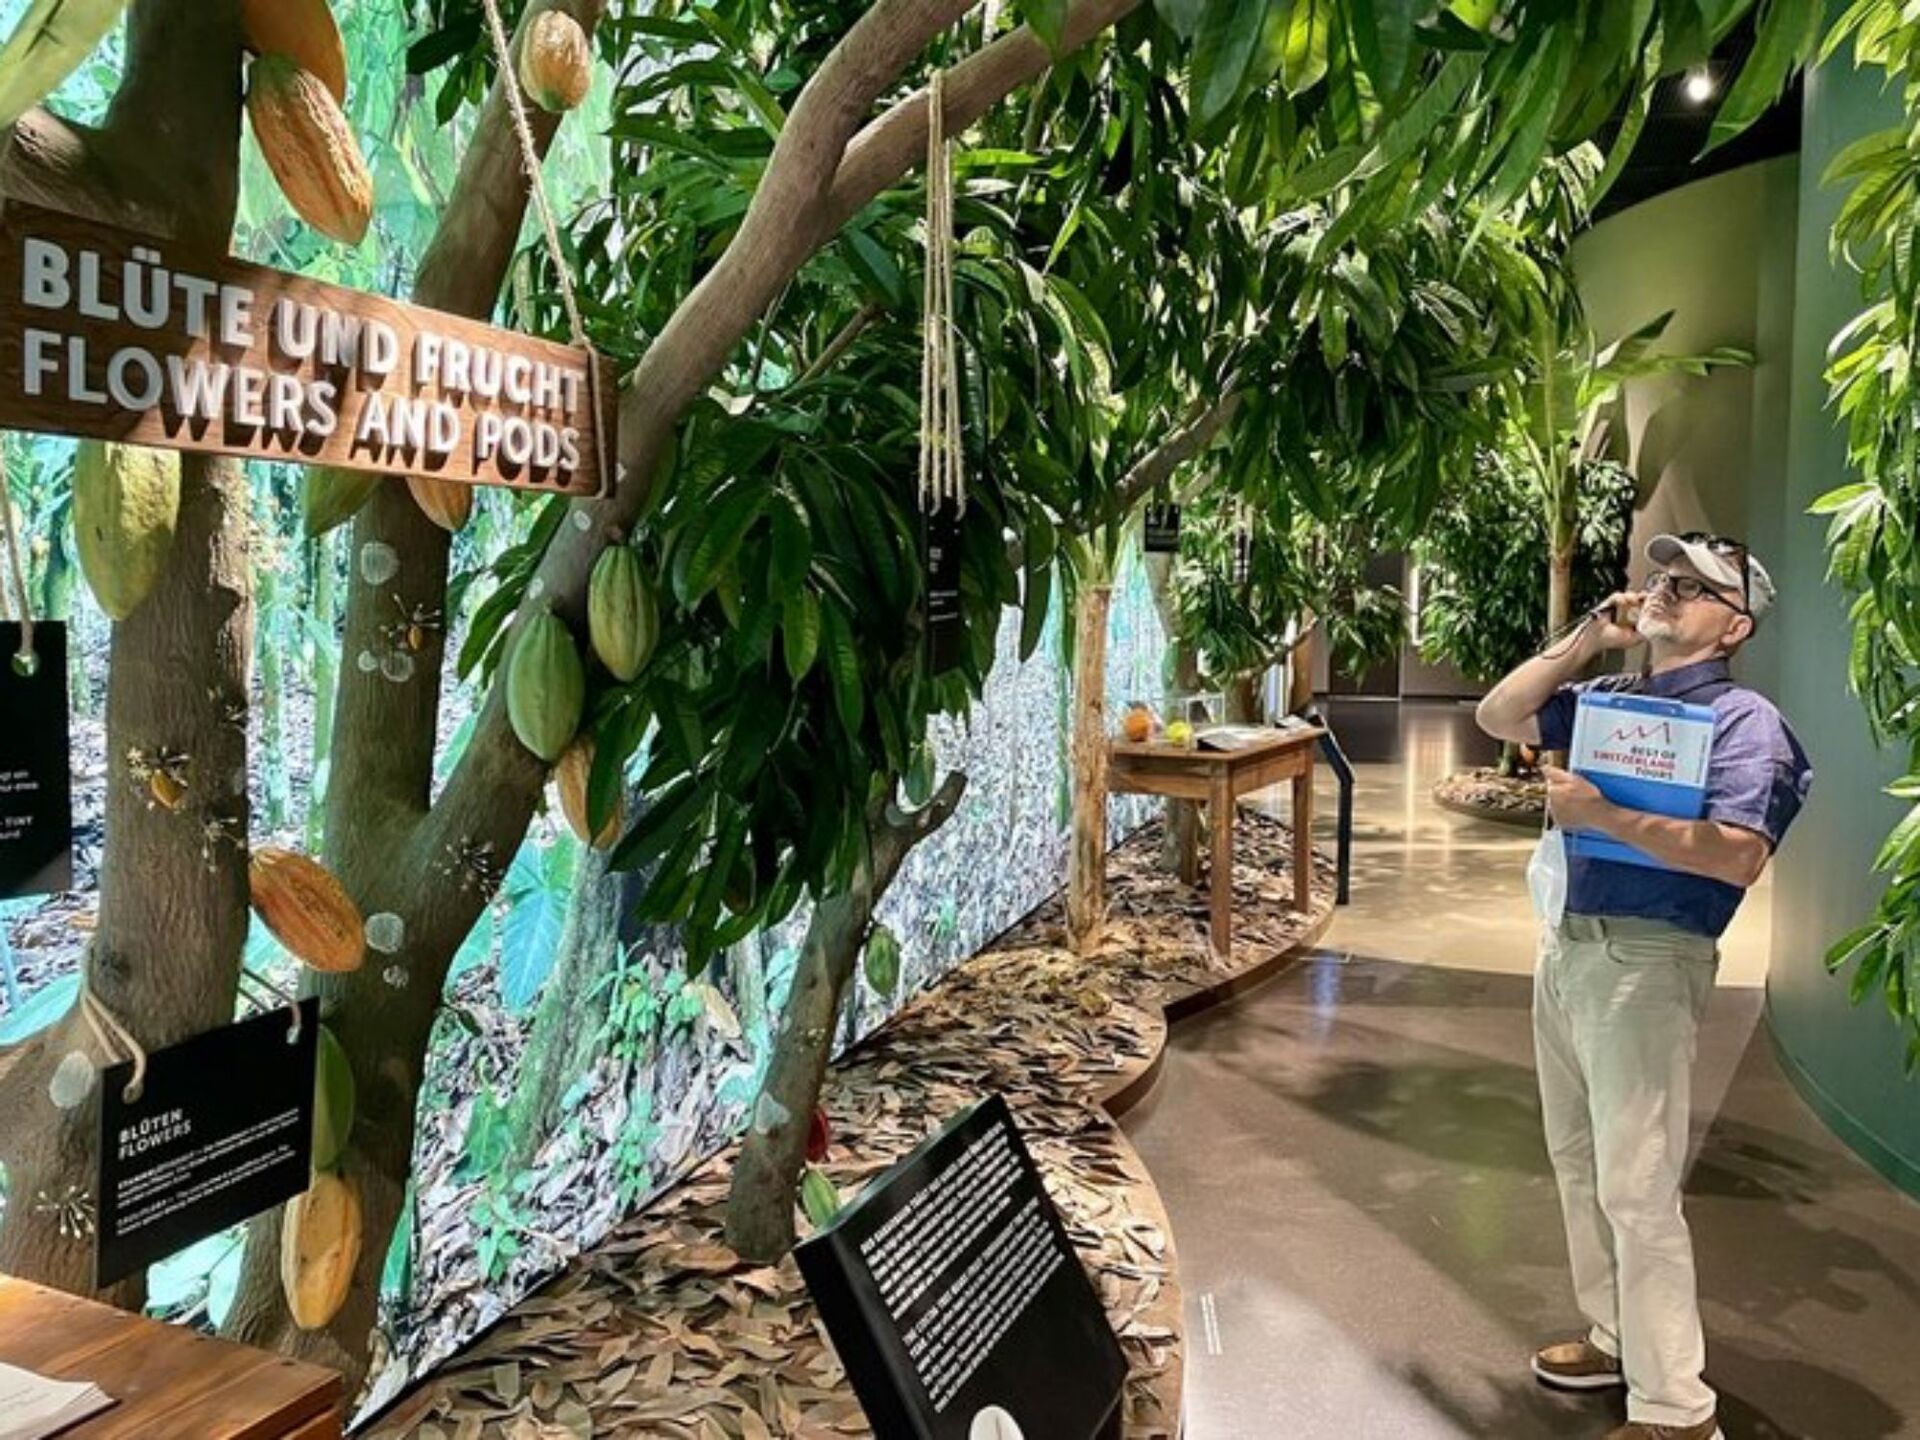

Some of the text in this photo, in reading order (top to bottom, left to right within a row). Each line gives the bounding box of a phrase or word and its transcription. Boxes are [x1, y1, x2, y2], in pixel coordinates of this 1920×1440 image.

[23, 238, 585, 413] BLÜTE UND FRUCHT
[23, 328, 581, 470] FLOWERS AND PODS
[1593, 750, 1676, 770] SWITZERLAND
[118, 1119, 191, 1160] FLOWERS
